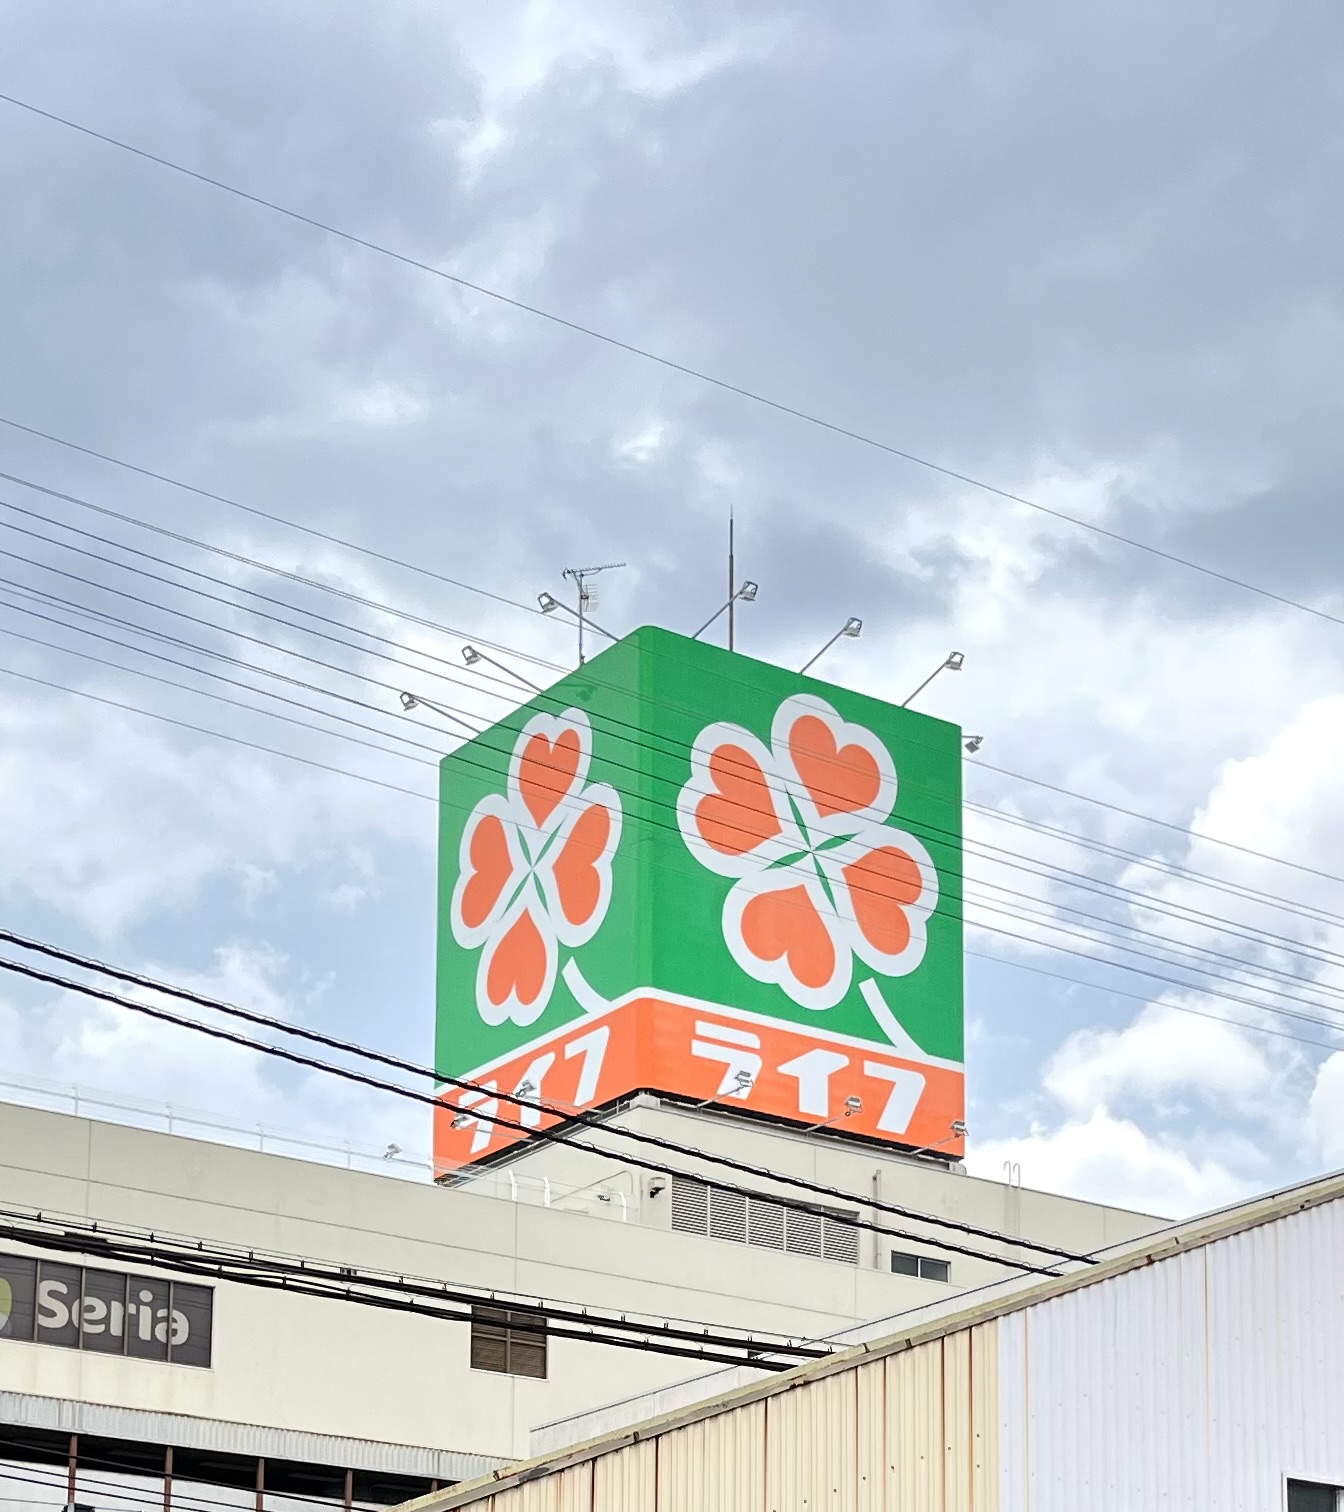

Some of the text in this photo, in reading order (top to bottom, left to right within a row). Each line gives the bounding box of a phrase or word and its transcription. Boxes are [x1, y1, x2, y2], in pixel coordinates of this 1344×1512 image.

[454, 1025, 610, 1155] ライフ
[690, 1018, 927, 1135] ライフ
[37, 1279, 190, 1346] Seria
